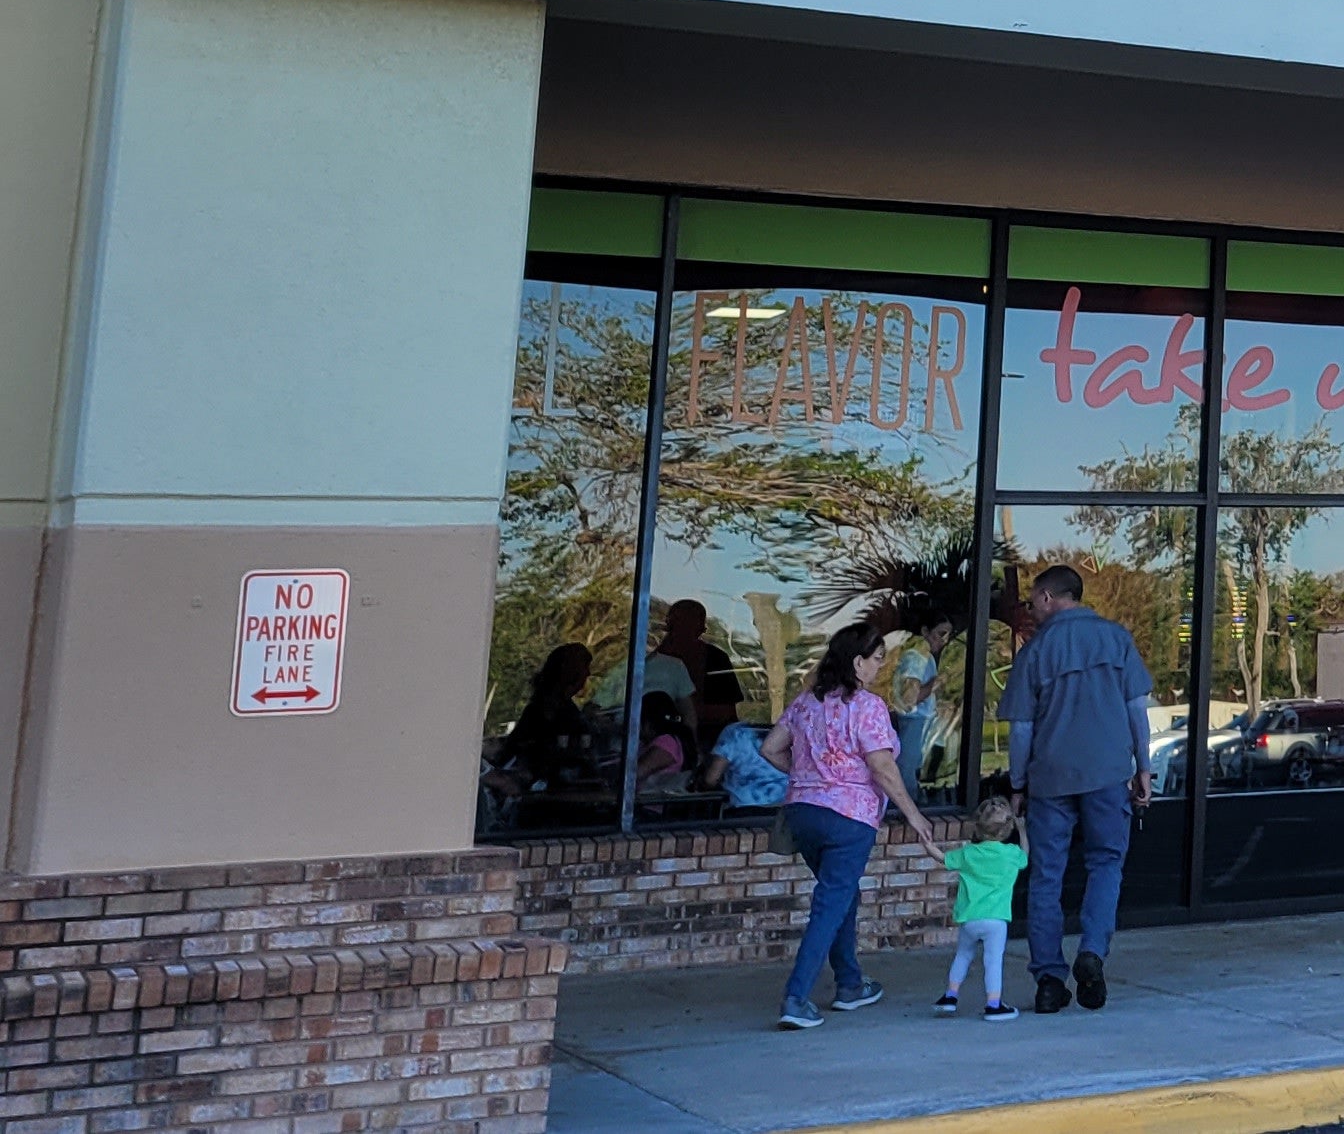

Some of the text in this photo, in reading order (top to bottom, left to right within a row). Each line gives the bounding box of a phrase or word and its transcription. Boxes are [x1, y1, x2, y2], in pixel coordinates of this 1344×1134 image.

[684, 290, 968, 431] FLAVOR
[1039, 286, 1290, 411] take
[274, 583, 314, 610] NO
[245, 614, 338, 642] PARKING
[264, 644, 315, 663] FIRE
[262, 665, 314, 684] LANE
